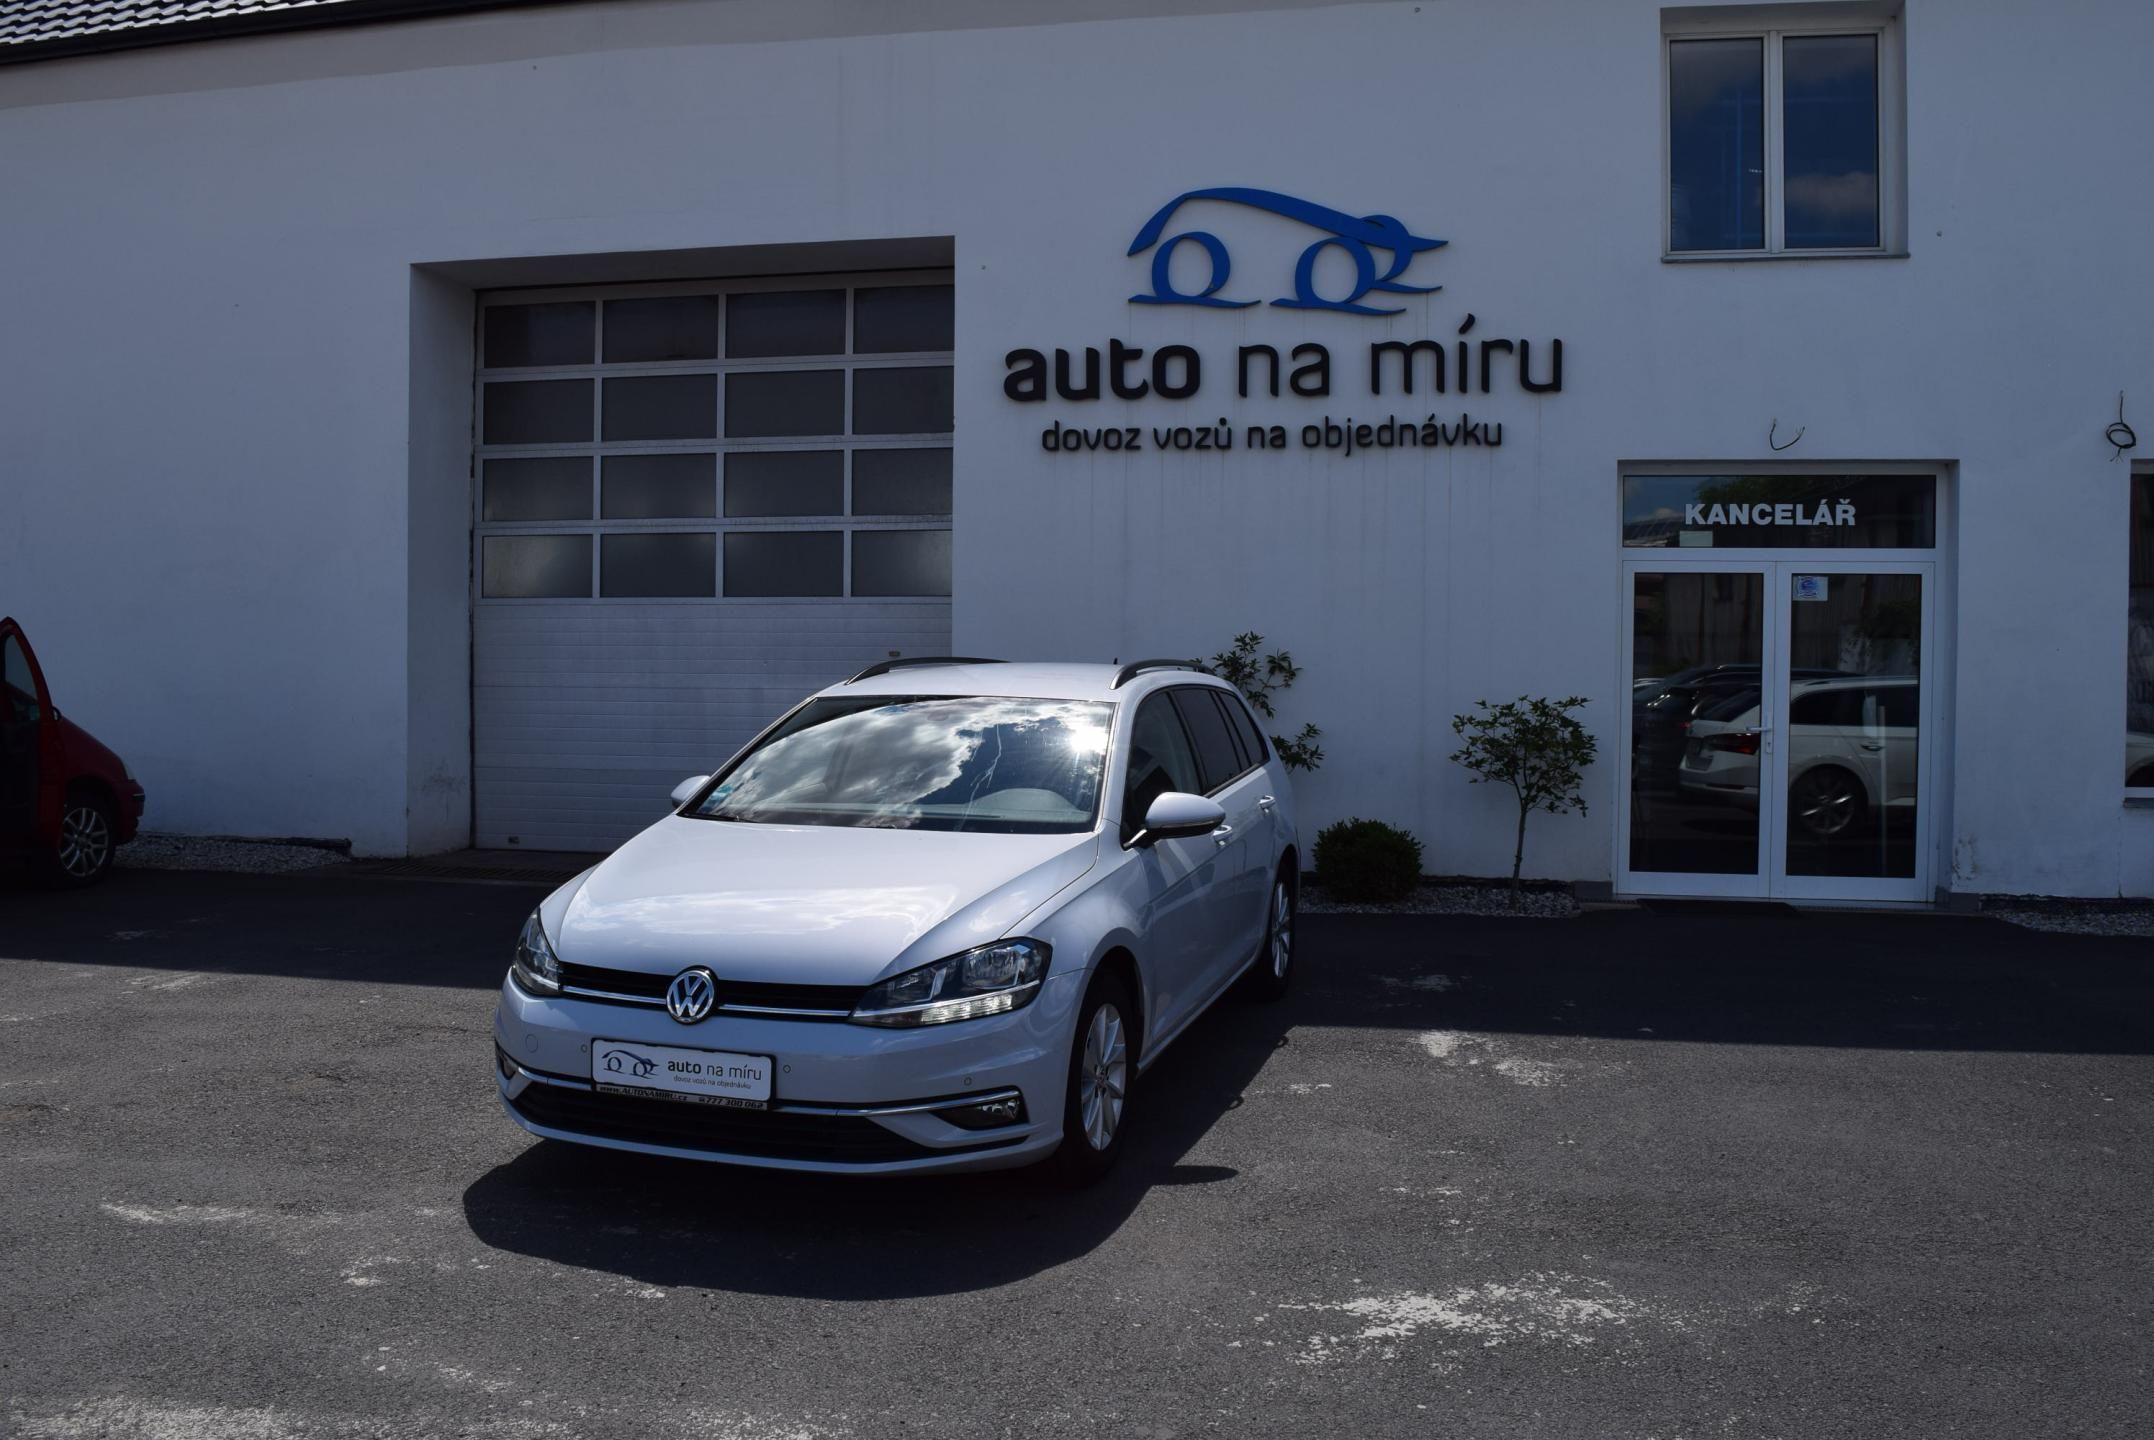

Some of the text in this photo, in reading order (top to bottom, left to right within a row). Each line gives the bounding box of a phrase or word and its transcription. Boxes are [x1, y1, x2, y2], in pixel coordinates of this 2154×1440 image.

[1003, 313, 1563, 402] auto na míru
[1041, 413, 1503, 458] dovoz vozů na objednávku
[1685, 498, 1857, 526] KANCELÁŘ
[667, 1060, 762, 1081] auto na míru
[673, 1075, 691, 1084] dovoz
